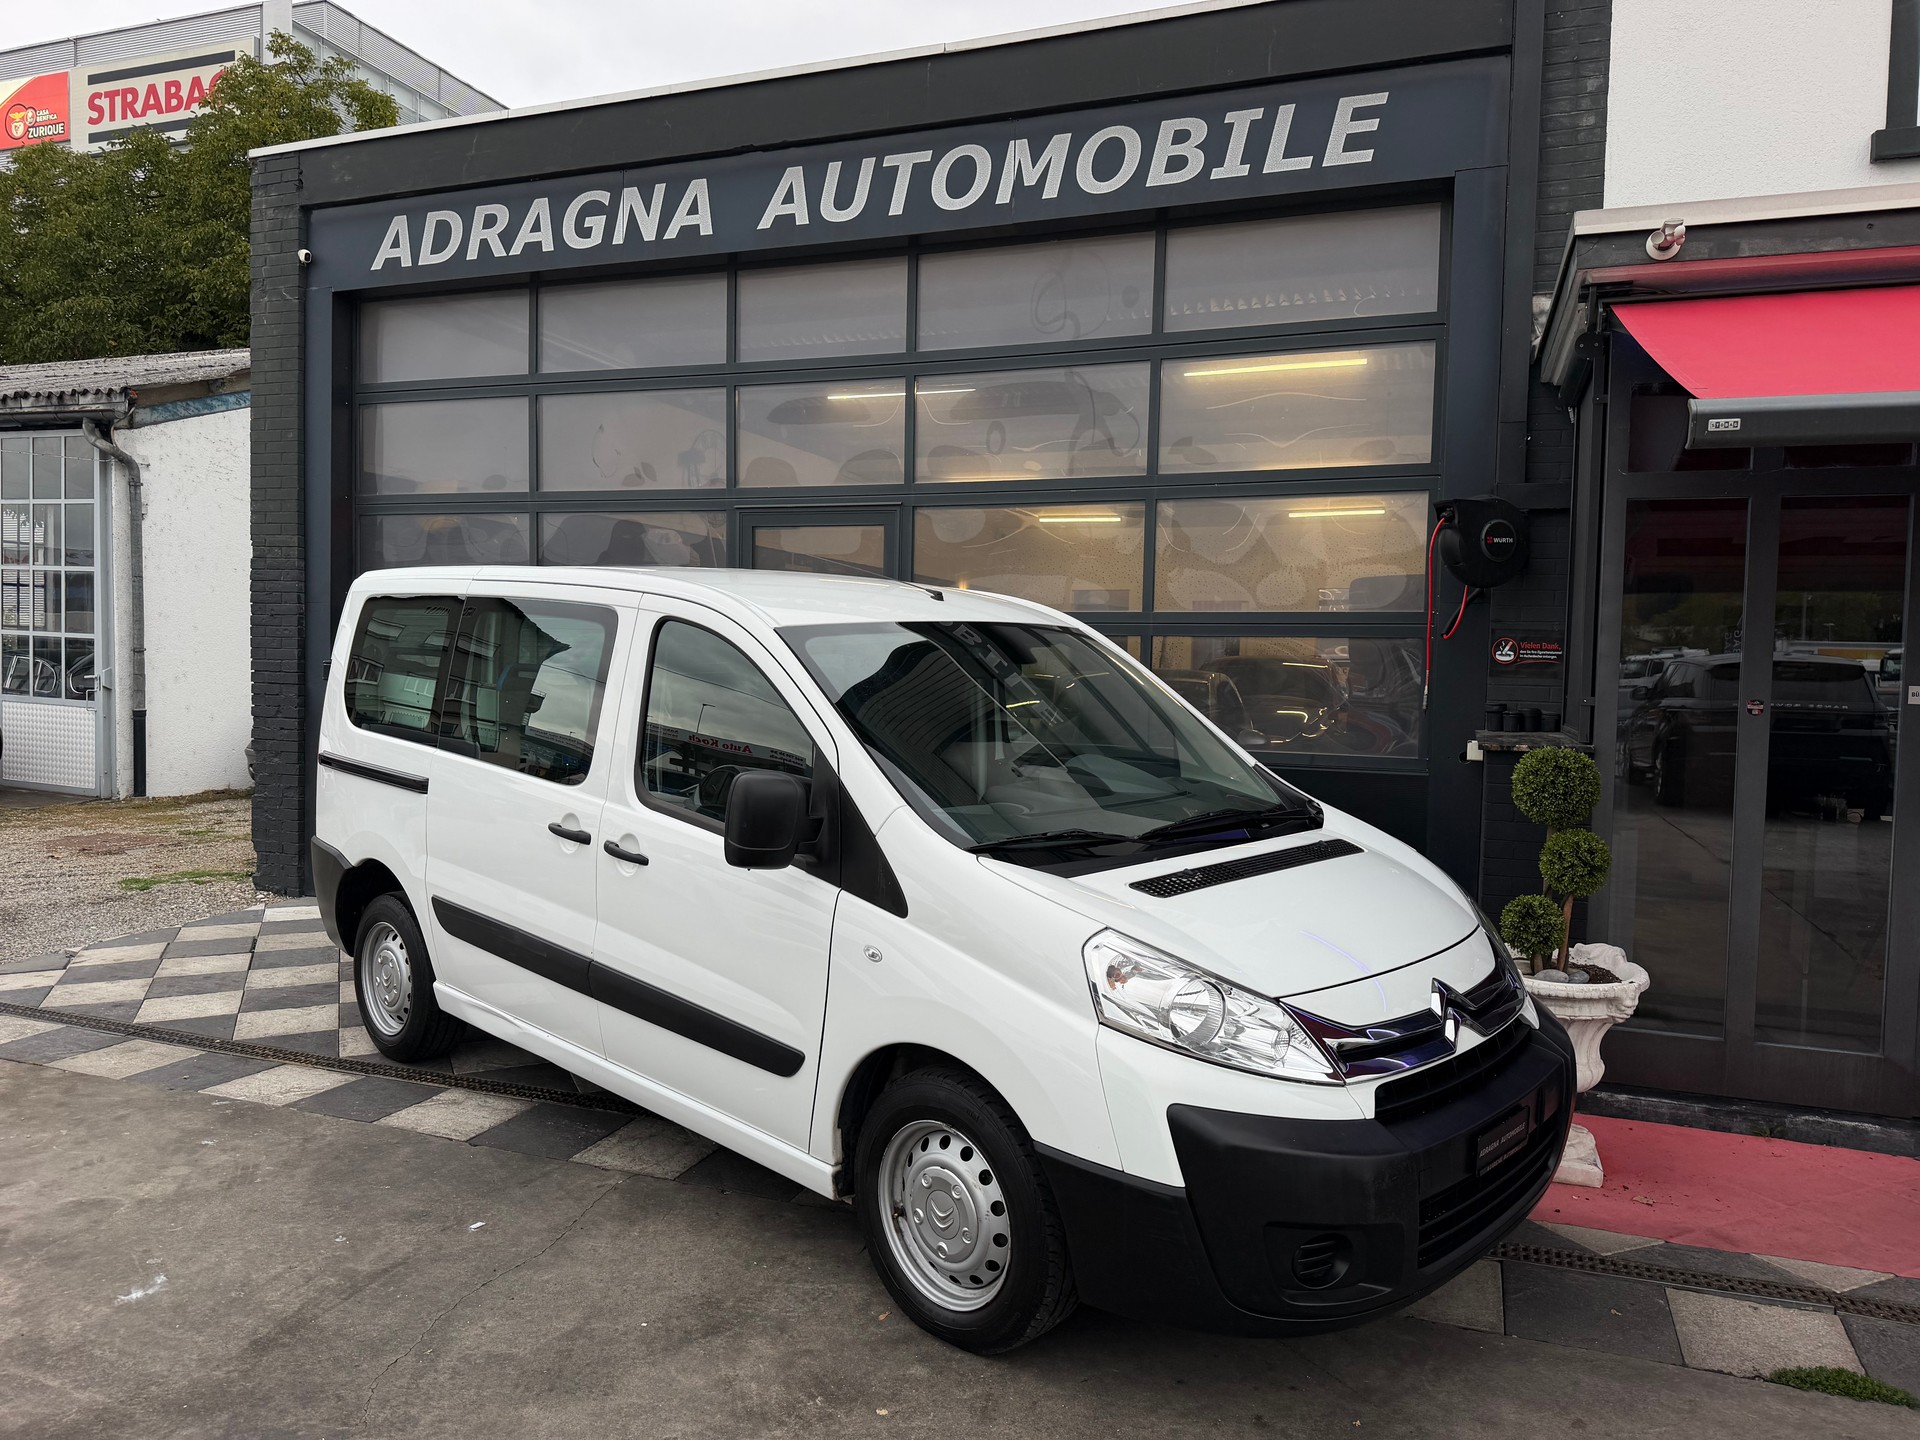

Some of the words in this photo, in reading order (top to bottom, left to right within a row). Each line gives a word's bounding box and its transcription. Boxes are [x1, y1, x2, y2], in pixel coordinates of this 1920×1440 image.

[36, 114, 58, 122] BENFICA
[28, 123, 65, 138] ZURIQUE
[370, 178, 714, 271] ADRAGNA
[756, 92, 1390, 231] AUTOMOBILE
[1520, 641, 1541, 649] Vielen
[1479, 1139, 1500, 1158] ADRAGNA
[1500, 1121, 1526, 1144] AUTOMOBILE
